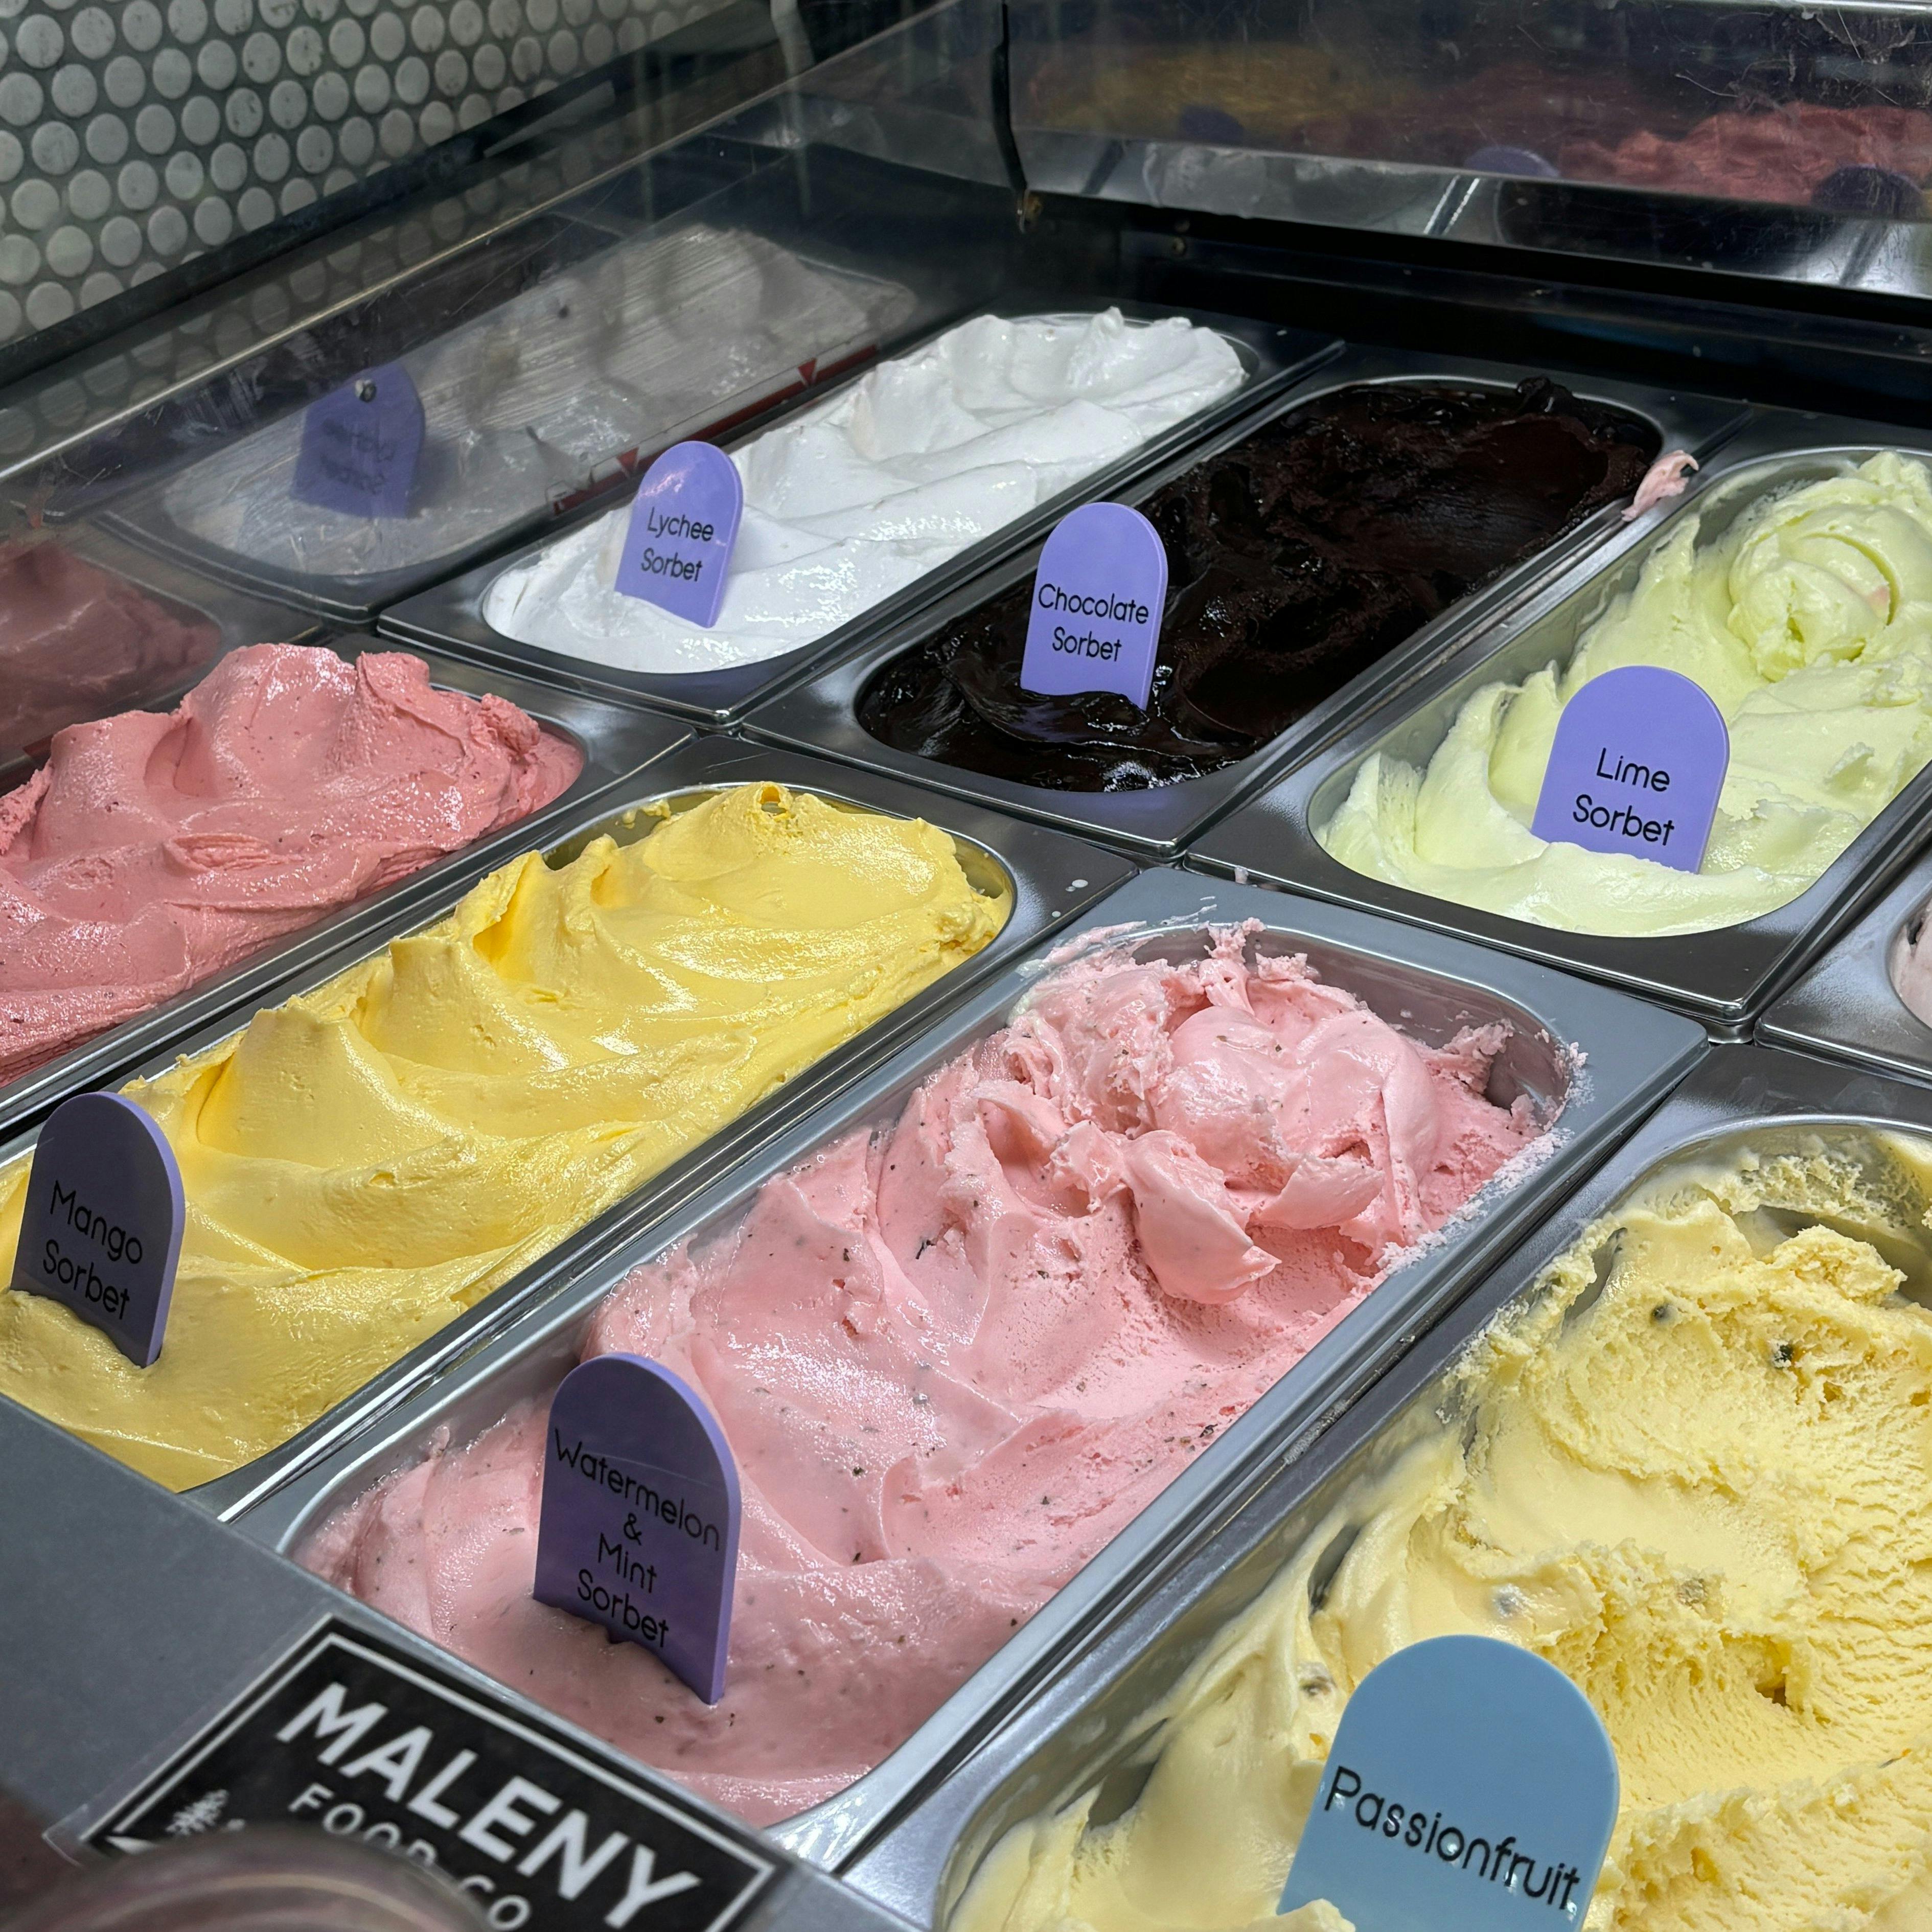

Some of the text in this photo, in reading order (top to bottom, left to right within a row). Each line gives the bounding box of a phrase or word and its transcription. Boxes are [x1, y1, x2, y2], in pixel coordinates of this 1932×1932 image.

[647, 507, 714, 541] Lychee
[641, 548, 703, 582] Sorbet
[1038, 583, 1149, 625] Chocolate
[1052, 626, 1122, 662] Sorbet
[1596, 747, 1670, 792] Lime
[1573, 794, 1674, 846] Sorbet
[50, 1180, 143, 1264] Mango
[43, 1239, 130, 1320] Sorbet
[555, 1429, 720, 1551] Watermelon
[623, 1513, 642, 1546] &
[598, 1533, 657, 1593] Mint
[577, 1569, 669, 1648] Sorbet
[277, 1682, 702, 1929] MALENY
[1324, 1765, 1580, 1910] Passionfruit
